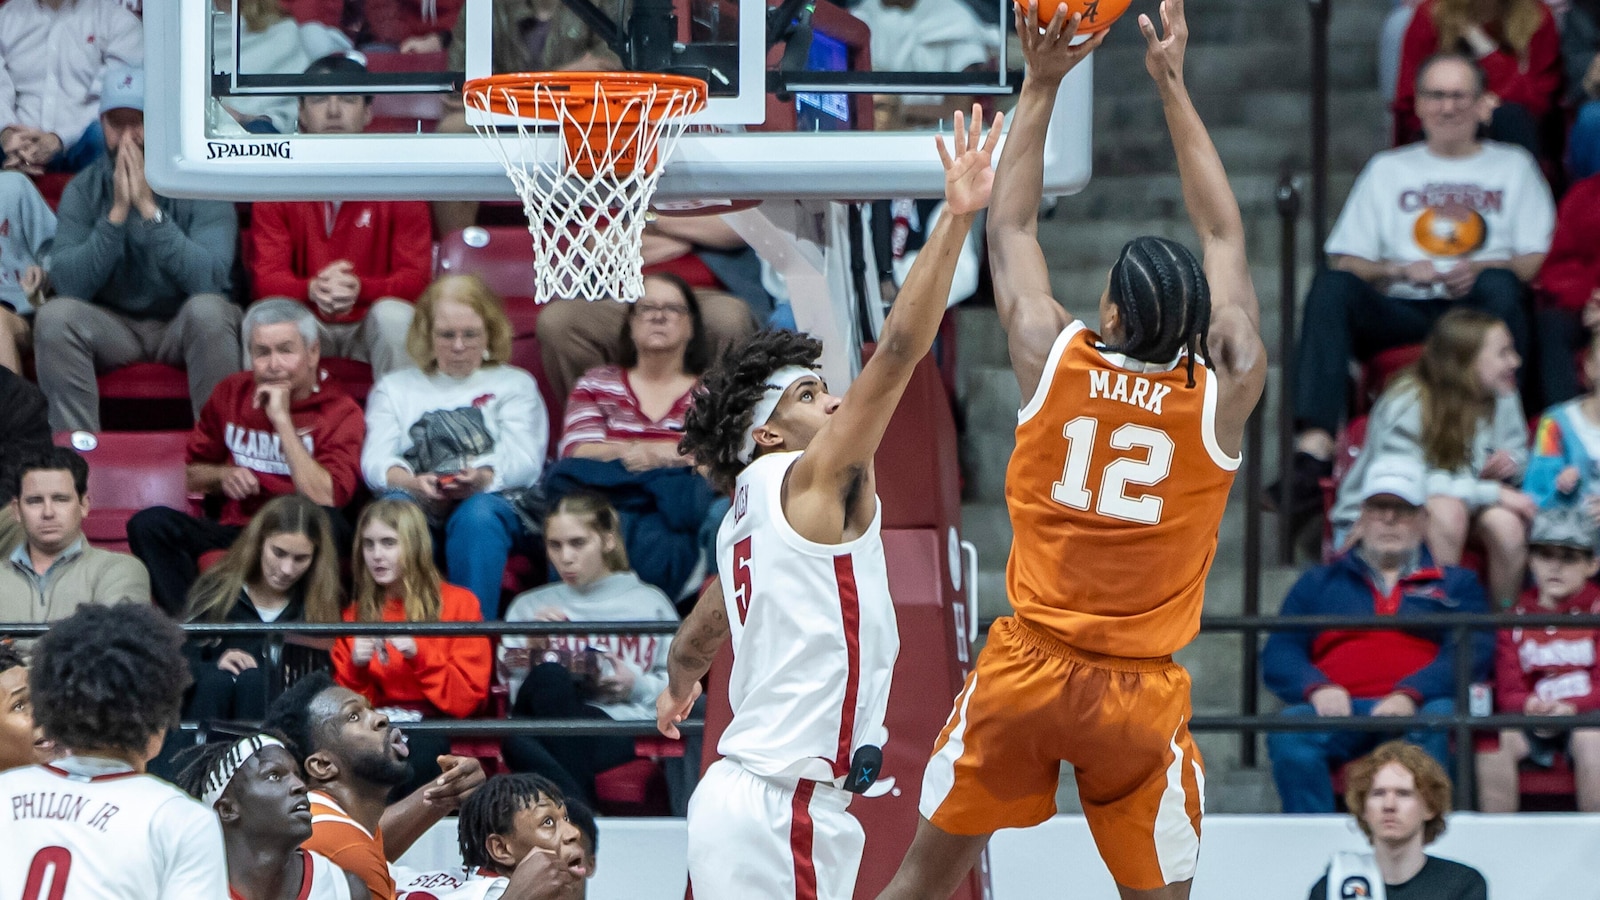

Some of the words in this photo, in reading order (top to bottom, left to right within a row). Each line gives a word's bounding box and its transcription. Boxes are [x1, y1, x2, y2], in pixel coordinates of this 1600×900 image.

[206, 141, 291, 160] SPALDING
[1089, 370, 1172, 415] MARK
[1051, 416, 1176, 525] 12
[733, 535, 752, 627] 5
[11, 792, 91, 822] PHILON
[86, 802, 120, 832] JR.
[21, 845, 72, 900] 0
